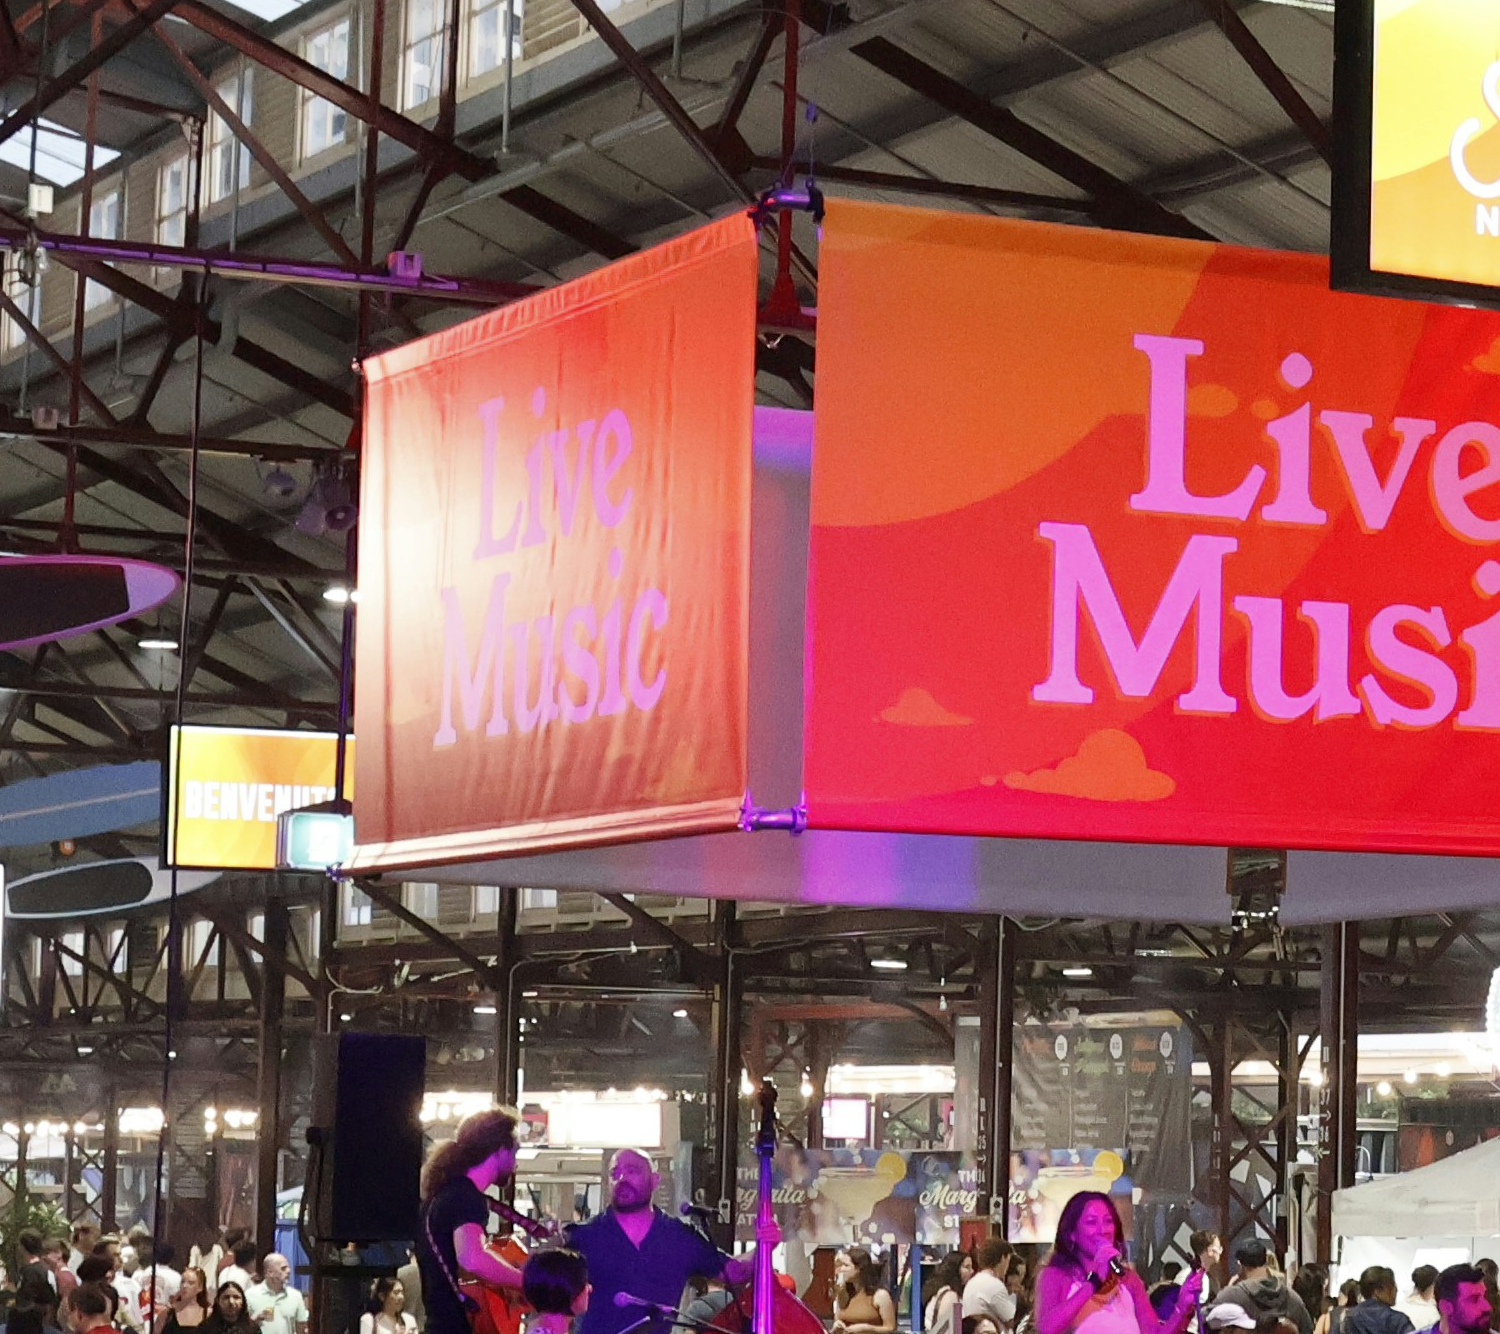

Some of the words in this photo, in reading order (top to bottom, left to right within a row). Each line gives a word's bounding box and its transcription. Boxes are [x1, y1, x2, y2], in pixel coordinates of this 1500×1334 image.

[472, 388, 635, 561] Live
[435, 564, 671, 748] Music
[185, 781, 337, 822] BENVENUT
[957, 1169, 978, 1183] TH
